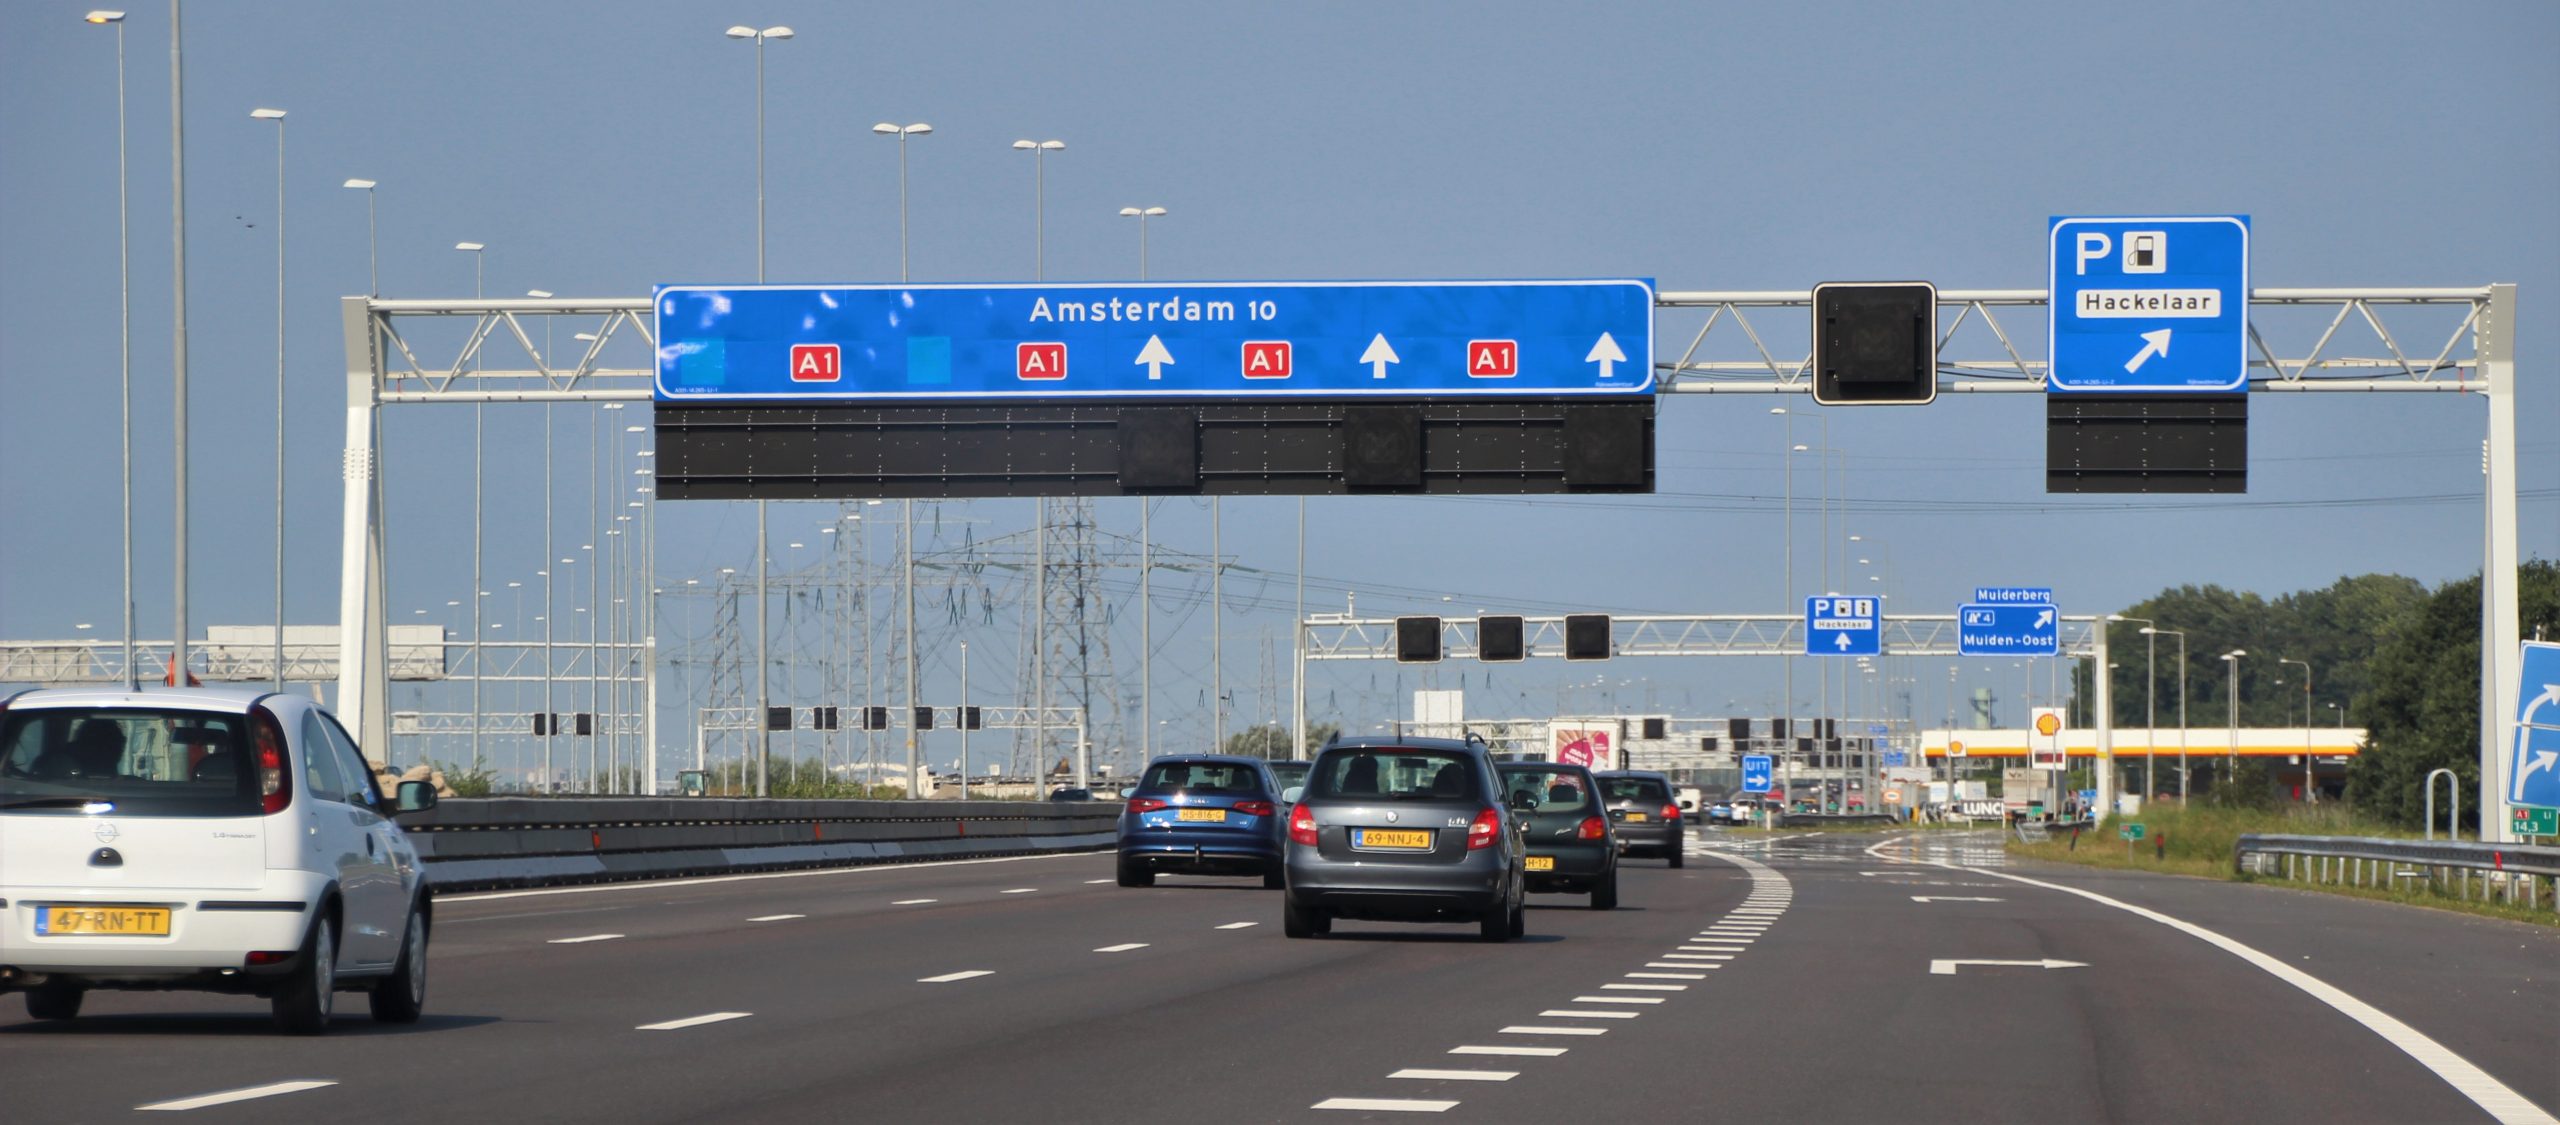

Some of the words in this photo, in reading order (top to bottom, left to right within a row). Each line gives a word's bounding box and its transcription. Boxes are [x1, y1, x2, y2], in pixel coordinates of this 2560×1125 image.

[1029, 297, 1234, 322] Amsterdam
[1248, 301, 1277, 321] 10
[2085, 293, 2211, 310] Hackelaar
[798, 353, 835, 374] A1
[1024, 351, 1060, 373] A1
[1249, 350, 1285, 372] A1
[1475, 349, 1510, 370] A1
[1977, 588, 2051, 604] Muiderberg
[1818, 620, 1868, 629] Hackelaar
[1982, 613, 1992, 623] 4
[1964, 634, 2053, 646] Muiden-Oost
[1746, 760, 1769, 771] UIT
[2516, 810, 2528, 819] A1
[1366, 832, 1424, 845] 69-NNJ-4
[1525, 858, 1548, 868] H-12
[56, 911, 161, 930] 47-RN-TT
